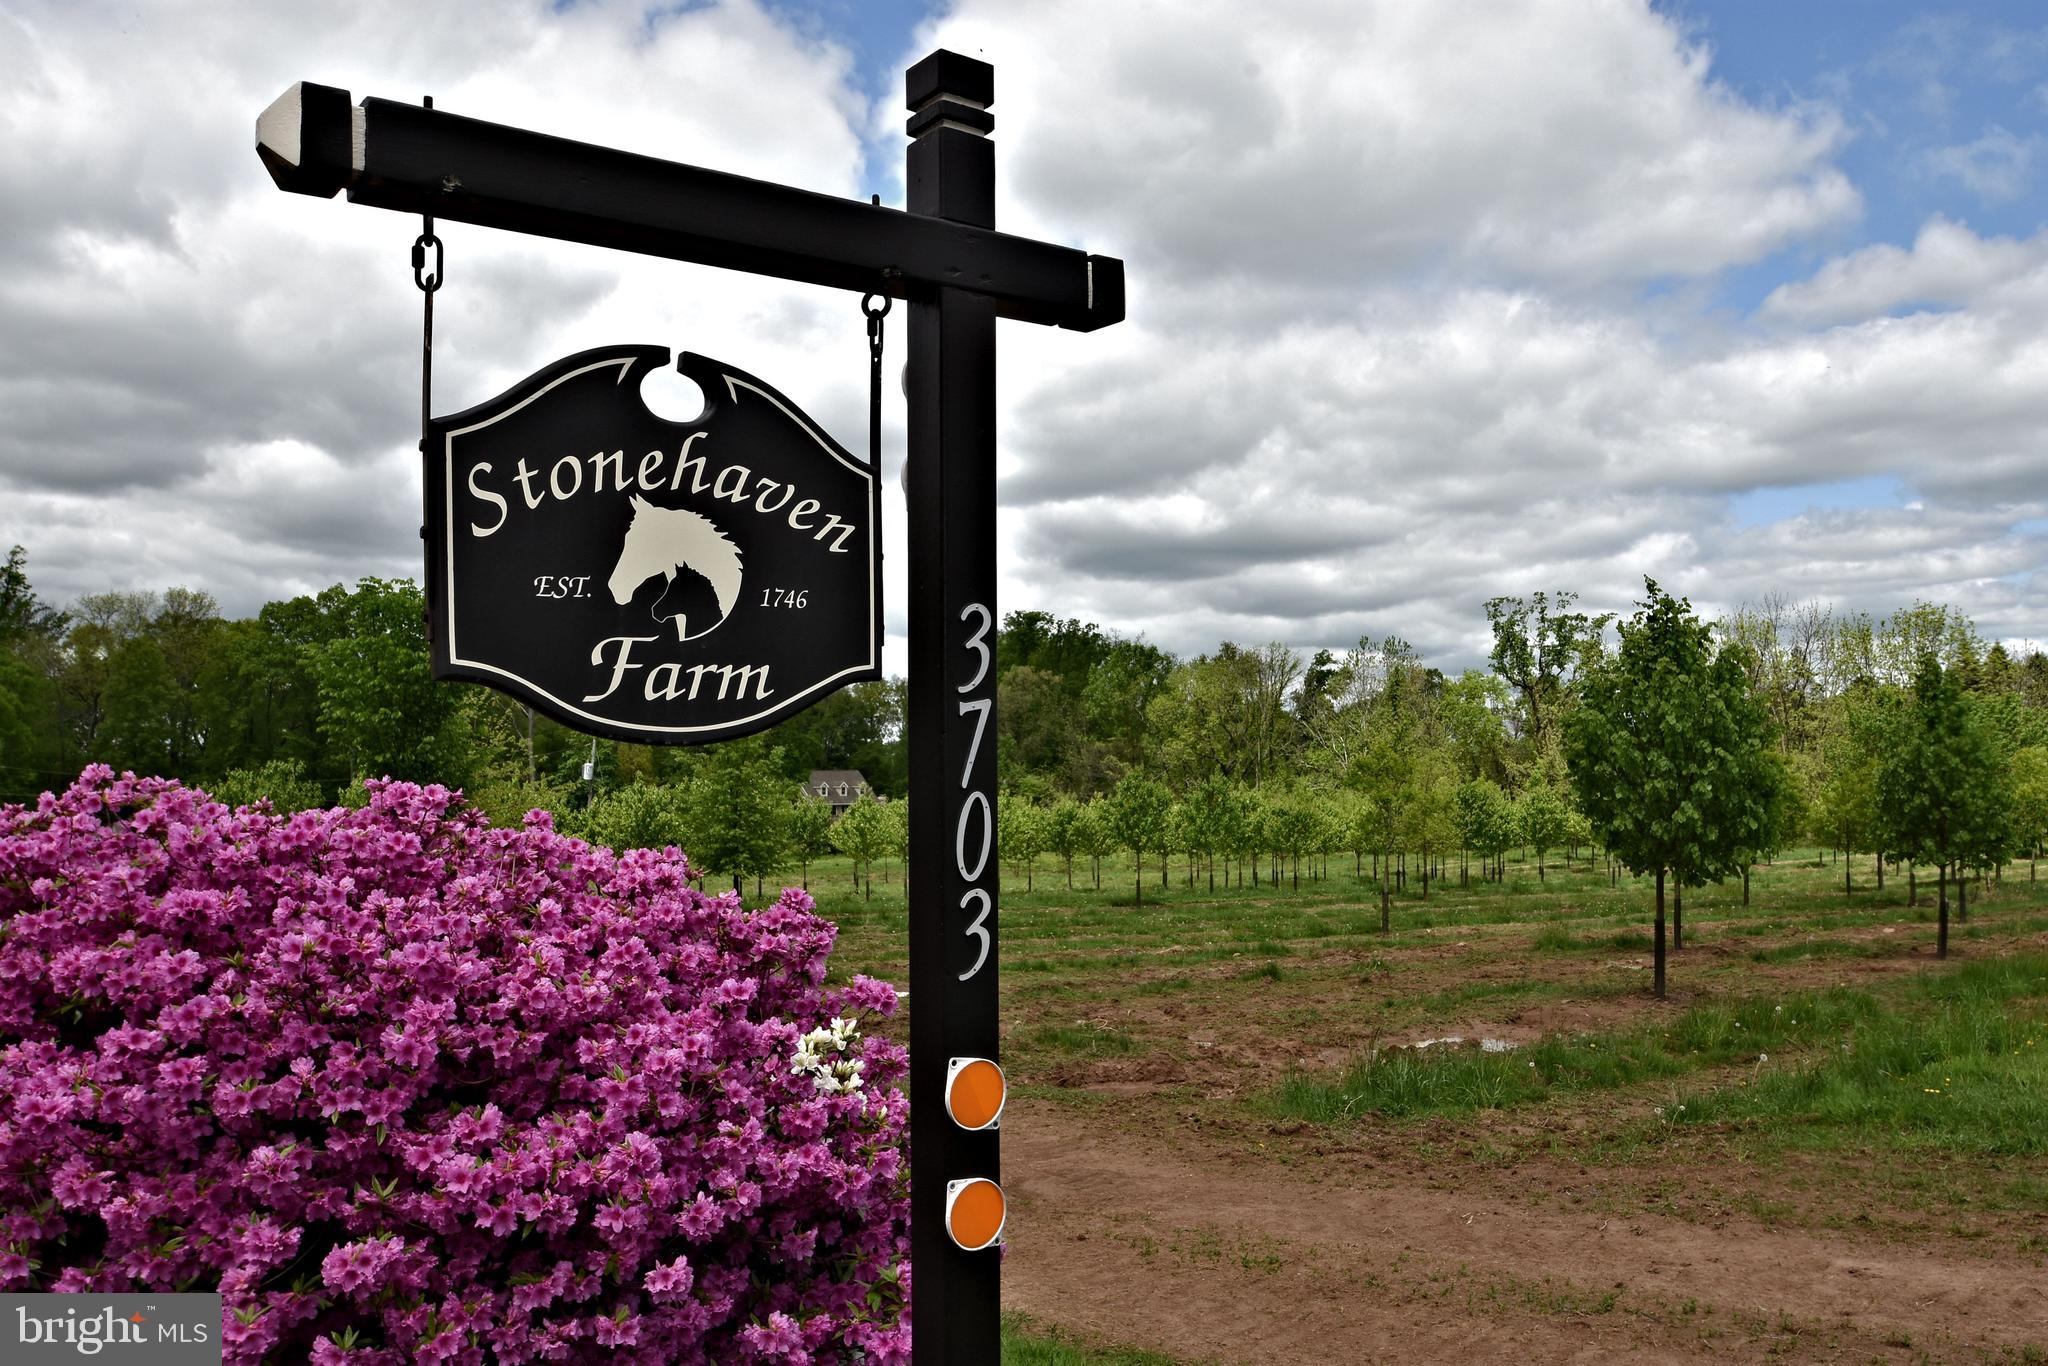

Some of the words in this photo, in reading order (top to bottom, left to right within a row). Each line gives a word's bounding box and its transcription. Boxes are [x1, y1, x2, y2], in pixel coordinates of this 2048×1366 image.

[468, 431, 857, 554] Stonehaven
[533, 575, 592, 600] EST.
[759, 587, 809, 609] 1746
[582, 635, 775, 703] Farm
[956, 602, 993, 982] 3703
